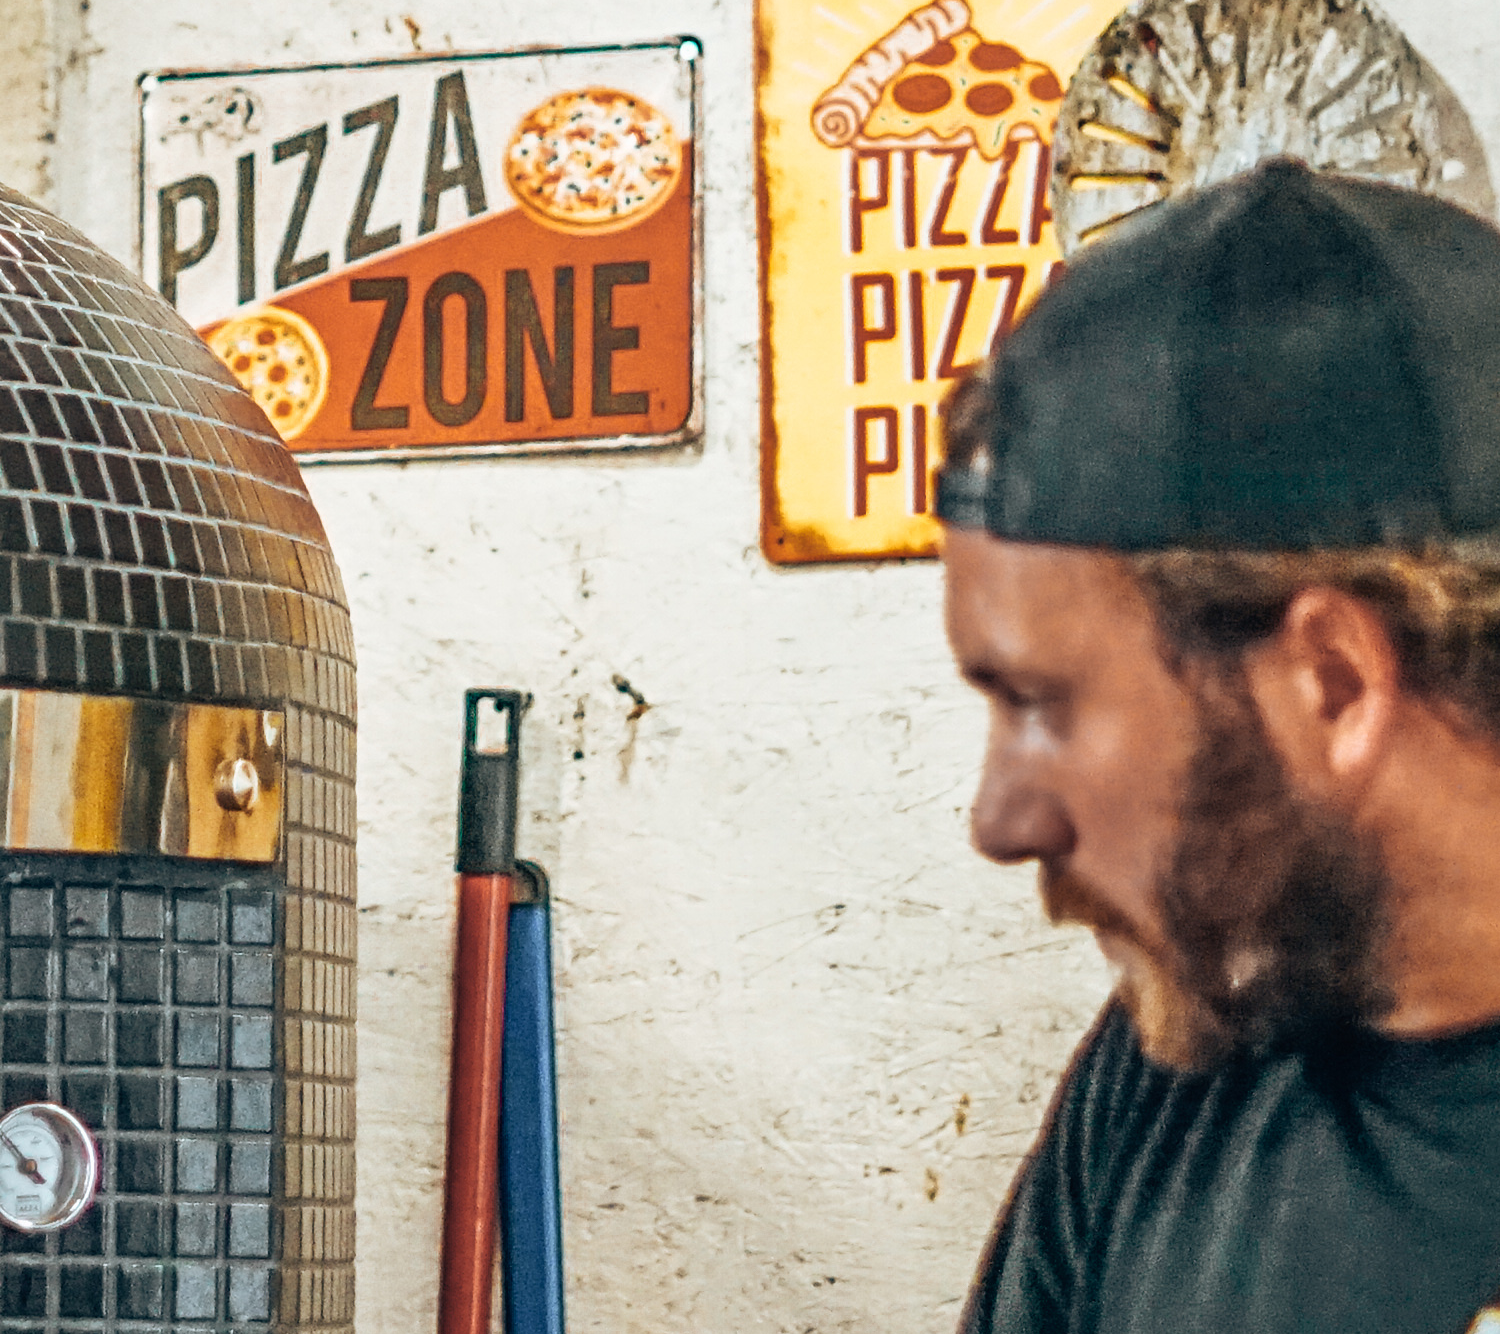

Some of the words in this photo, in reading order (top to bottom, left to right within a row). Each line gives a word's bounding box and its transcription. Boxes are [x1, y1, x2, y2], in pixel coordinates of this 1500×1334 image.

[157, 69, 488, 313] PIZZA
[349, 260, 651, 432] ZONE
[845, 260, 1066, 385] PIZZ
